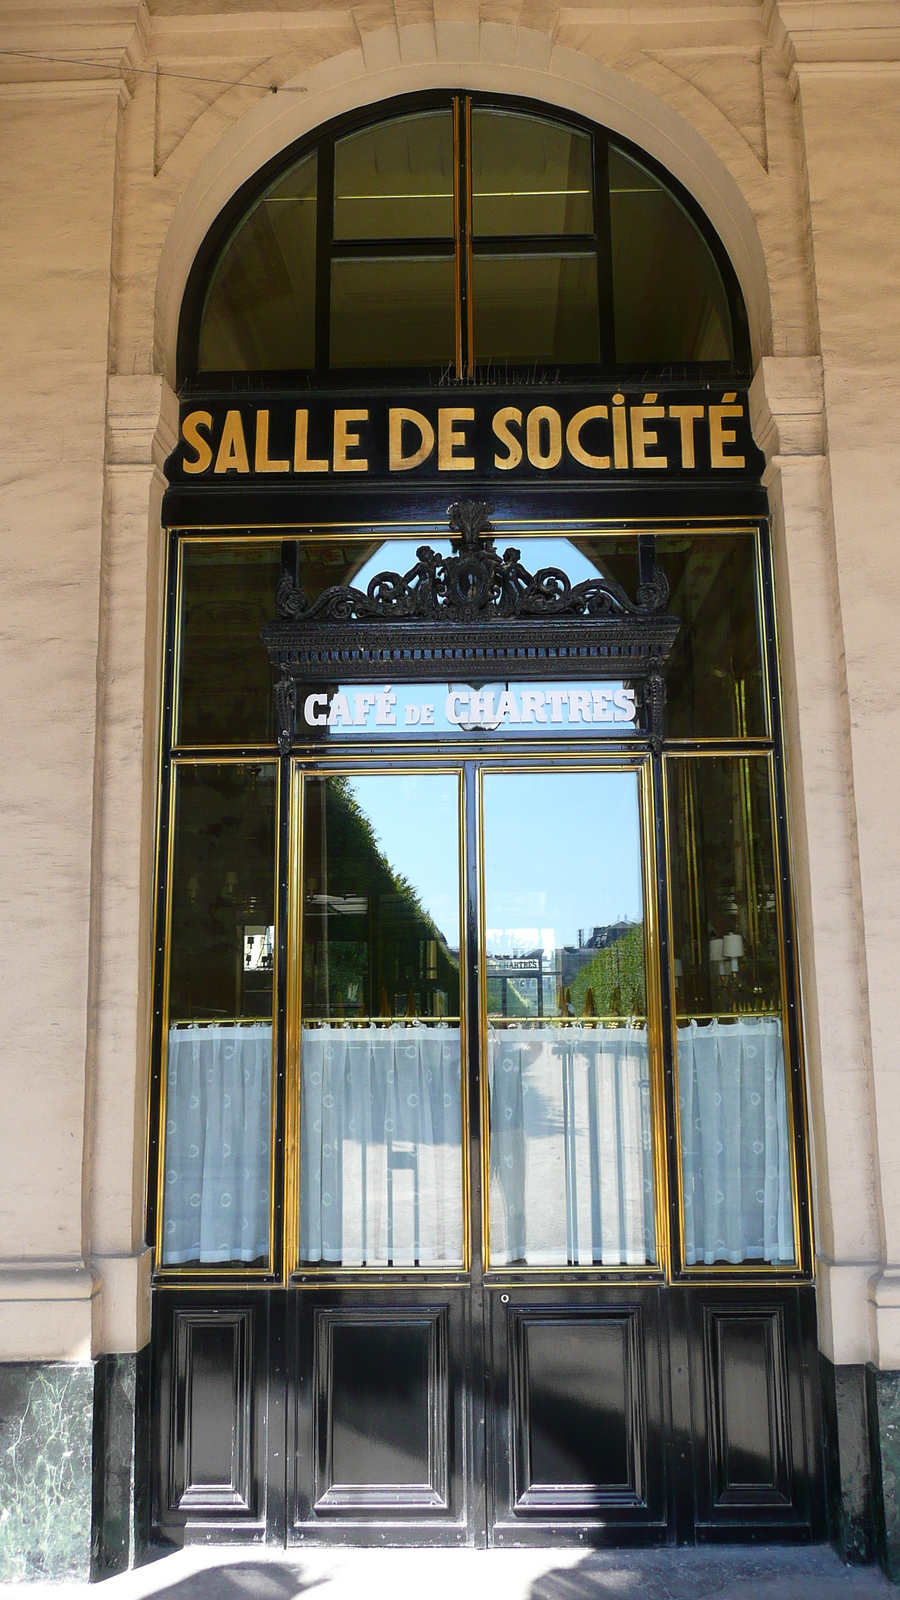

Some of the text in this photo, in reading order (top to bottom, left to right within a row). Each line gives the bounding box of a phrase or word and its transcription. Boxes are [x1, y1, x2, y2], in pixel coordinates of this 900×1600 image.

[182, 409, 368, 474] SALLE
[388, 407, 475, 471] DE
[304, 685, 636, 726] CAFÉ DE CHARTRES
